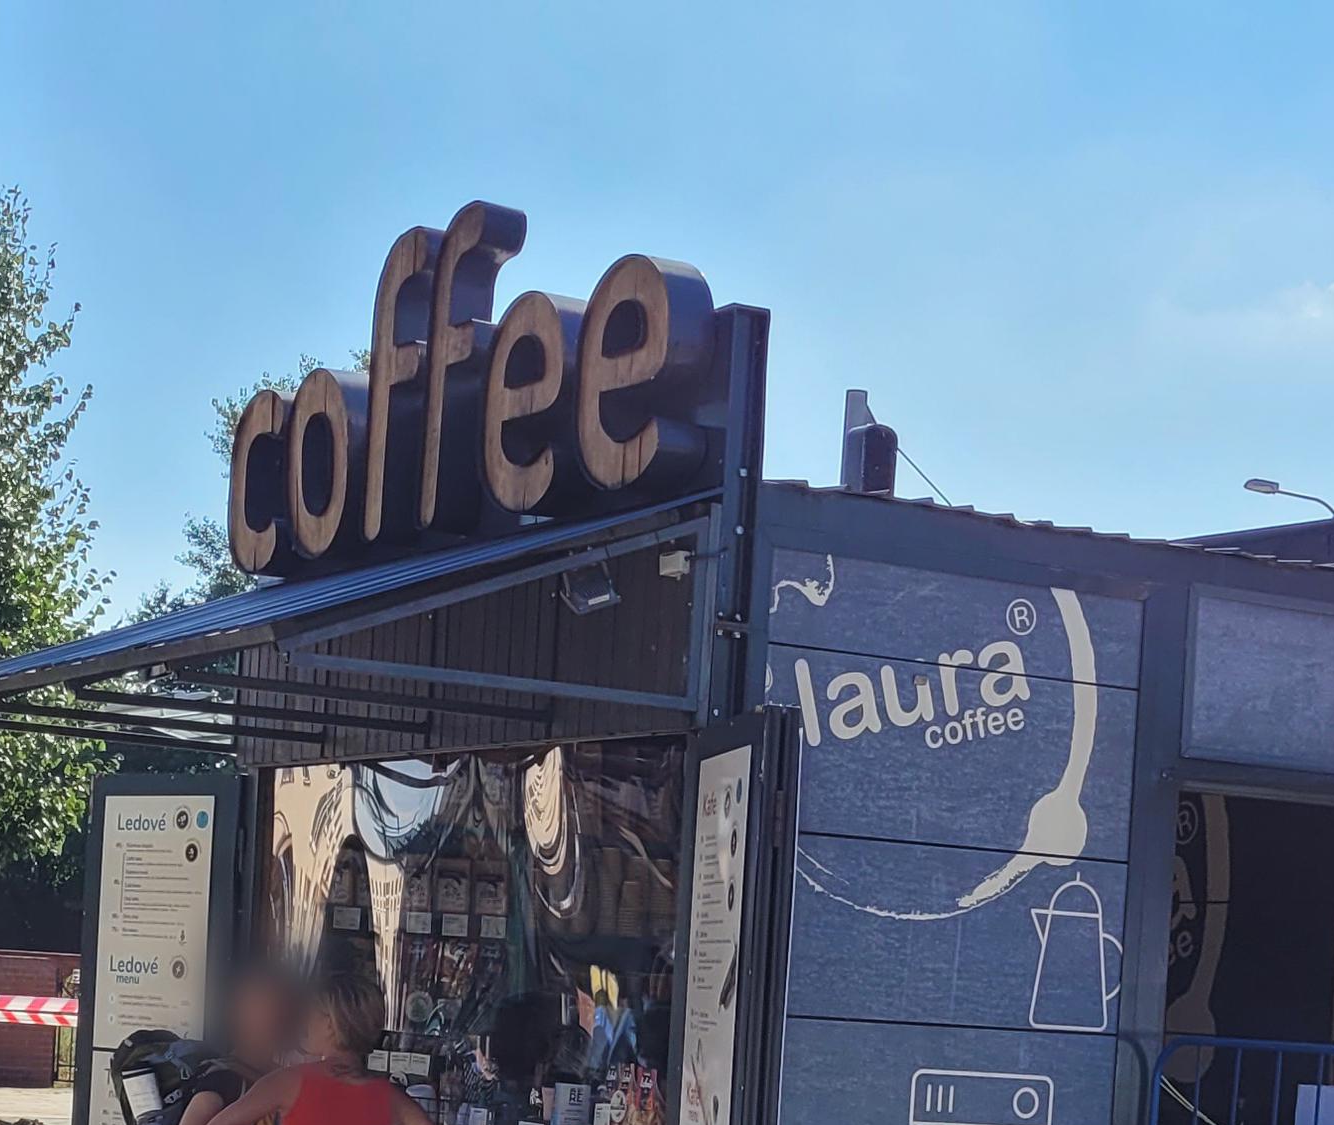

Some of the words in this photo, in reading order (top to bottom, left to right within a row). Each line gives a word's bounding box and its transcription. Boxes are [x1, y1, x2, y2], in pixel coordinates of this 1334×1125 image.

[228, 200, 713, 575] coffee
[794, 639, 1031, 747] laura
[924, 703, 1026, 749] coffee
[117, 812, 167, 832] Ledové
[109, 954, 159, 975] Ledové
[116, 974, 140, 985] menu
